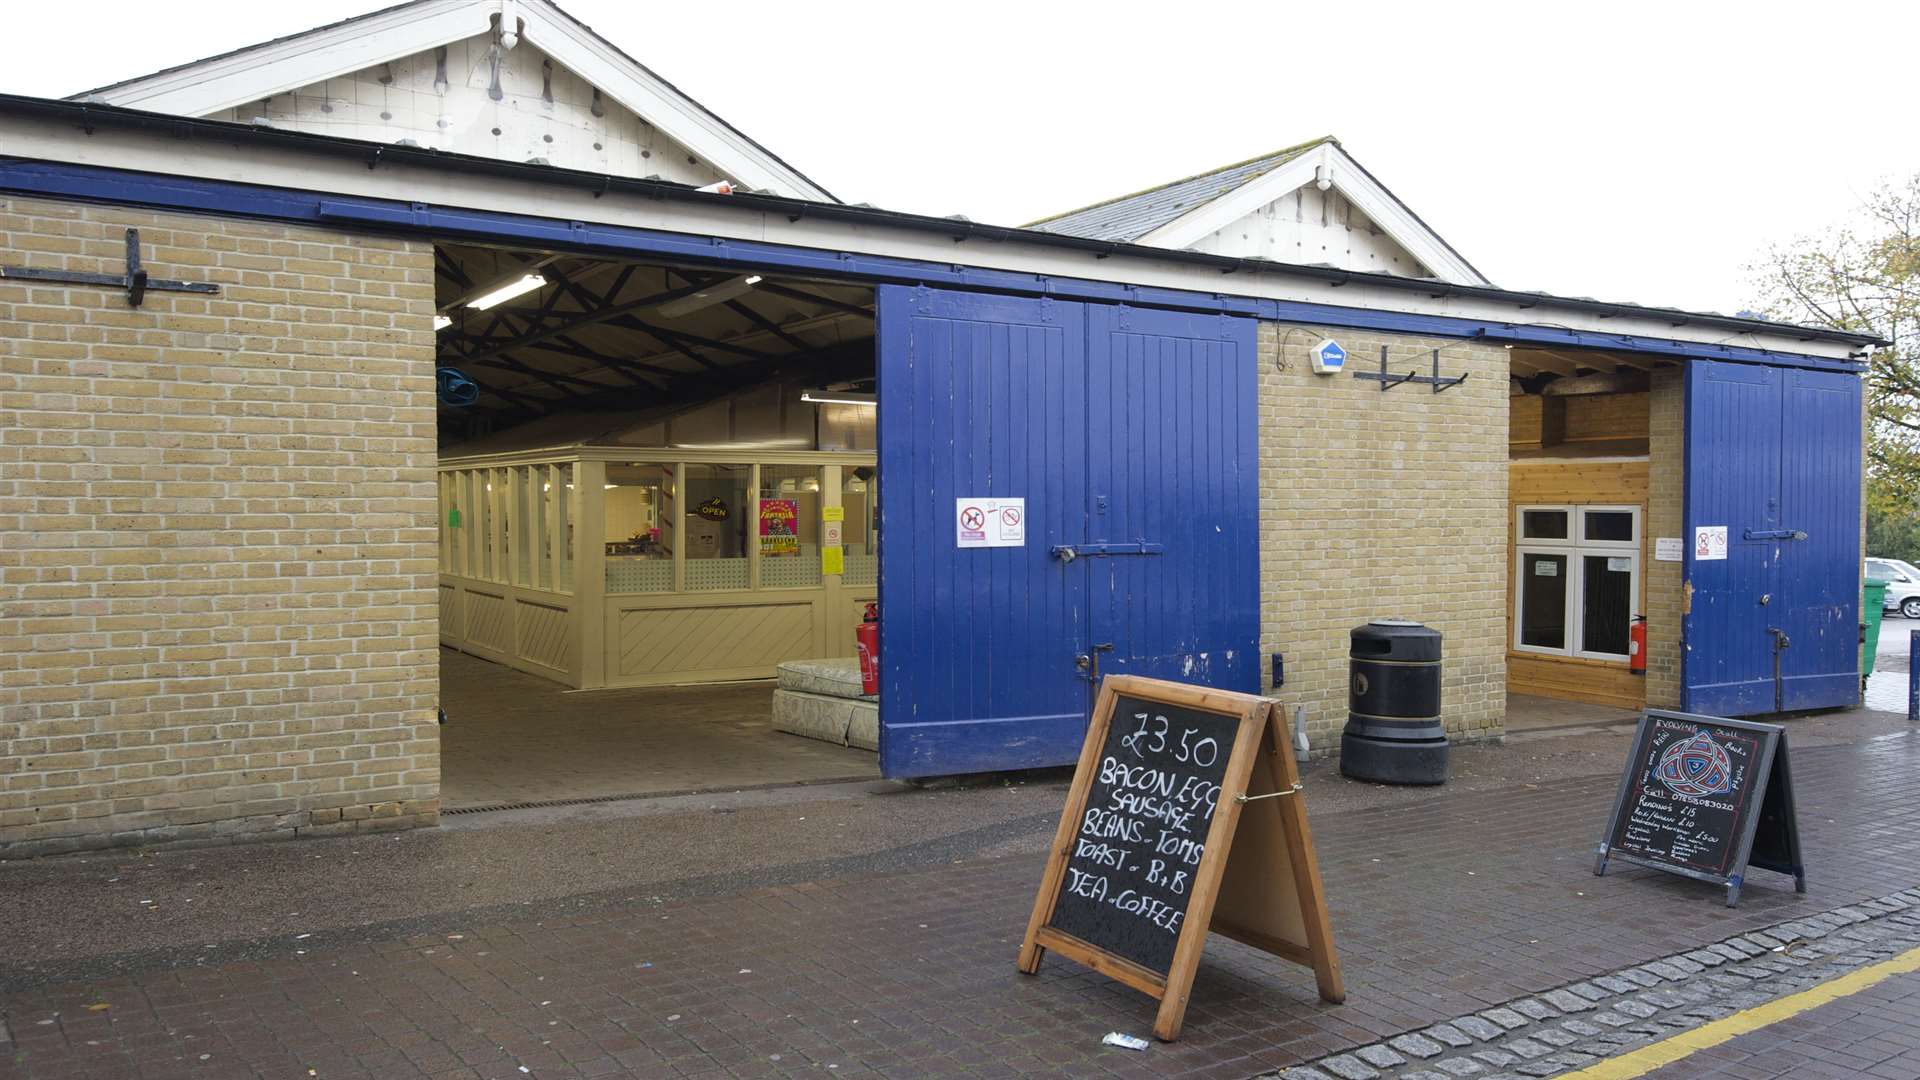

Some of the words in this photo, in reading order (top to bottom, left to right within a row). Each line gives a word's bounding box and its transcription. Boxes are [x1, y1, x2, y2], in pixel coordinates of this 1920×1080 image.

[702, 506, 727, 517] OPEN
[1121, 713, 1218, 767] £3.50
[1108, 788, 1194, 833] SAUSAGE
[1174, 776, 1222, 819] EGG
[1680, 806, 1696, 817] £15
[1081, 808, 1145, 842] BEANS
[1155, 830, 1204, 865] TOMS
[1678, 817, 1695, 827] £10
[1074, 838, 1132, 870] TOAST
[1067, 867, 1108, 902] TEA
[1115, 890, 1184, 934] COFFEE
